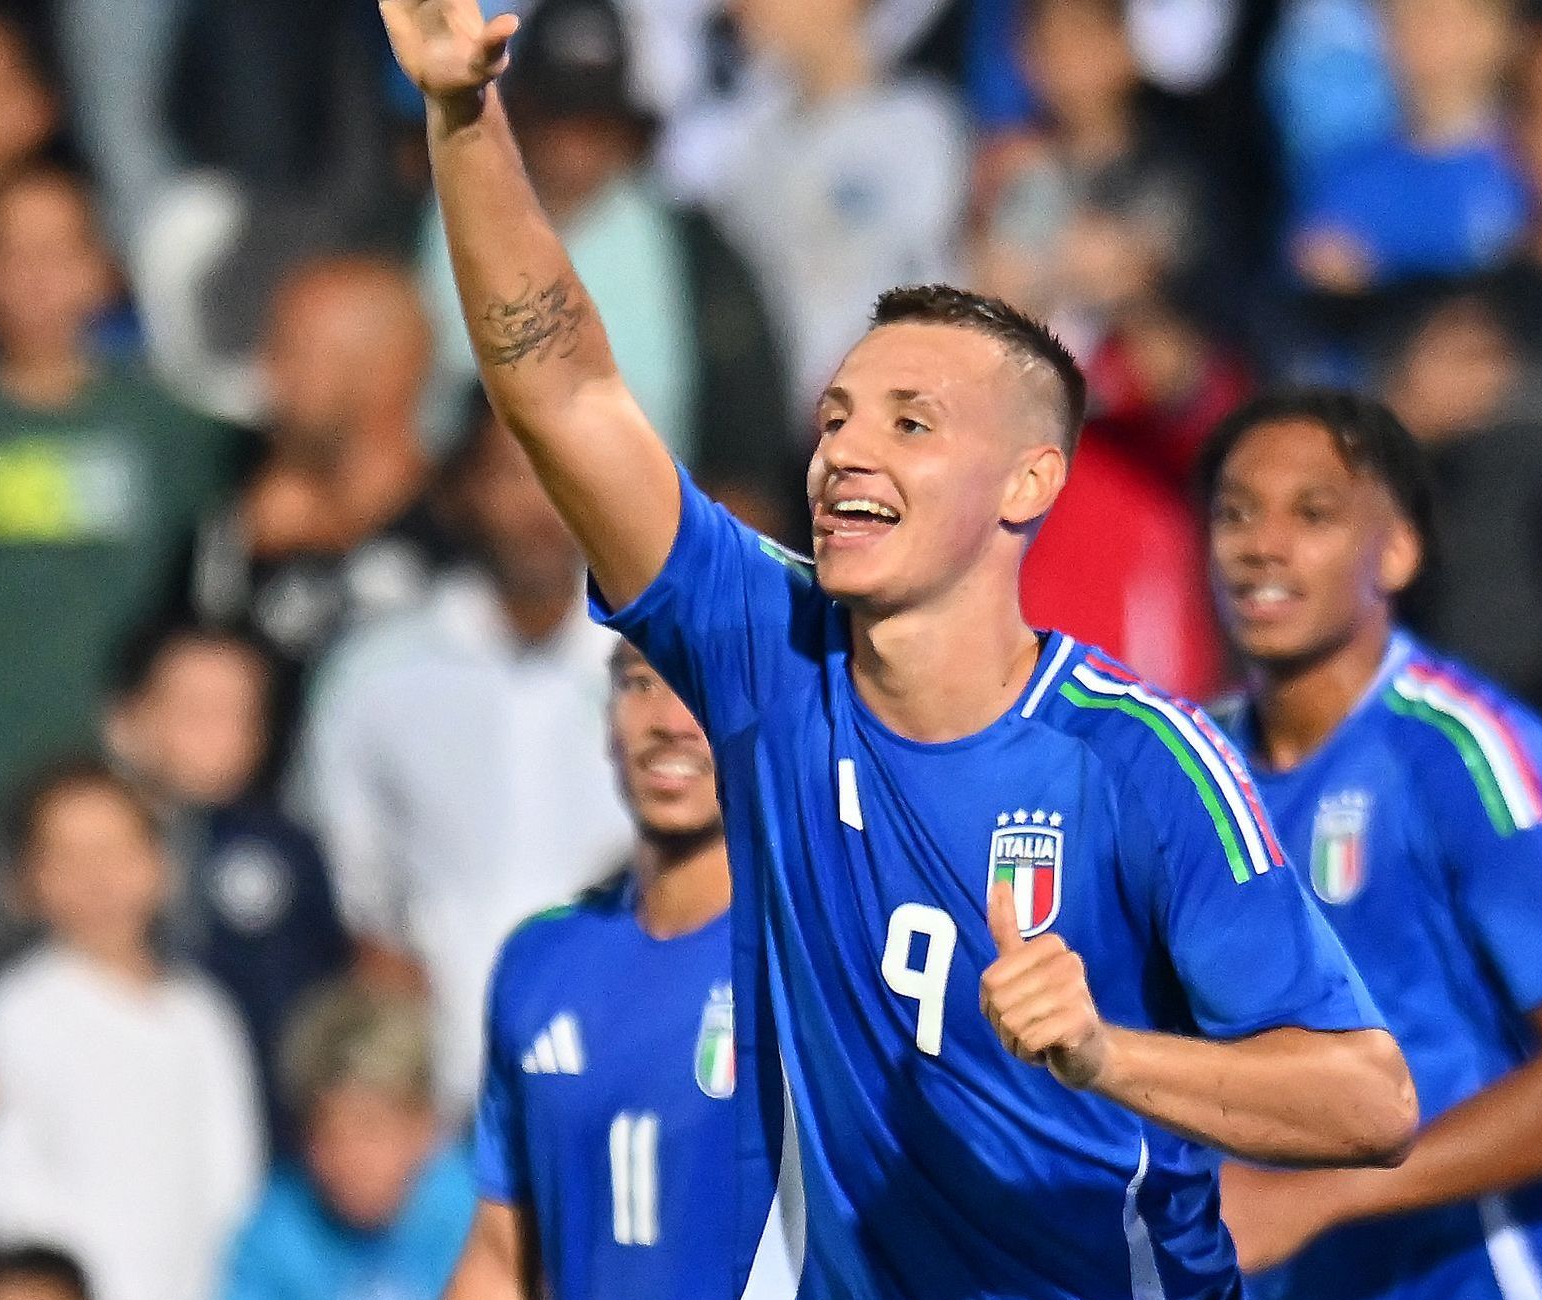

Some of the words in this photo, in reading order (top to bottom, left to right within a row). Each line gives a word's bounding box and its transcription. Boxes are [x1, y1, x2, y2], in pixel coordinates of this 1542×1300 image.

[997, 835, 1054, 859] ITALIA
[881, 902, 958, 1057] 9
[610, 1113, 659, 1245] 11
